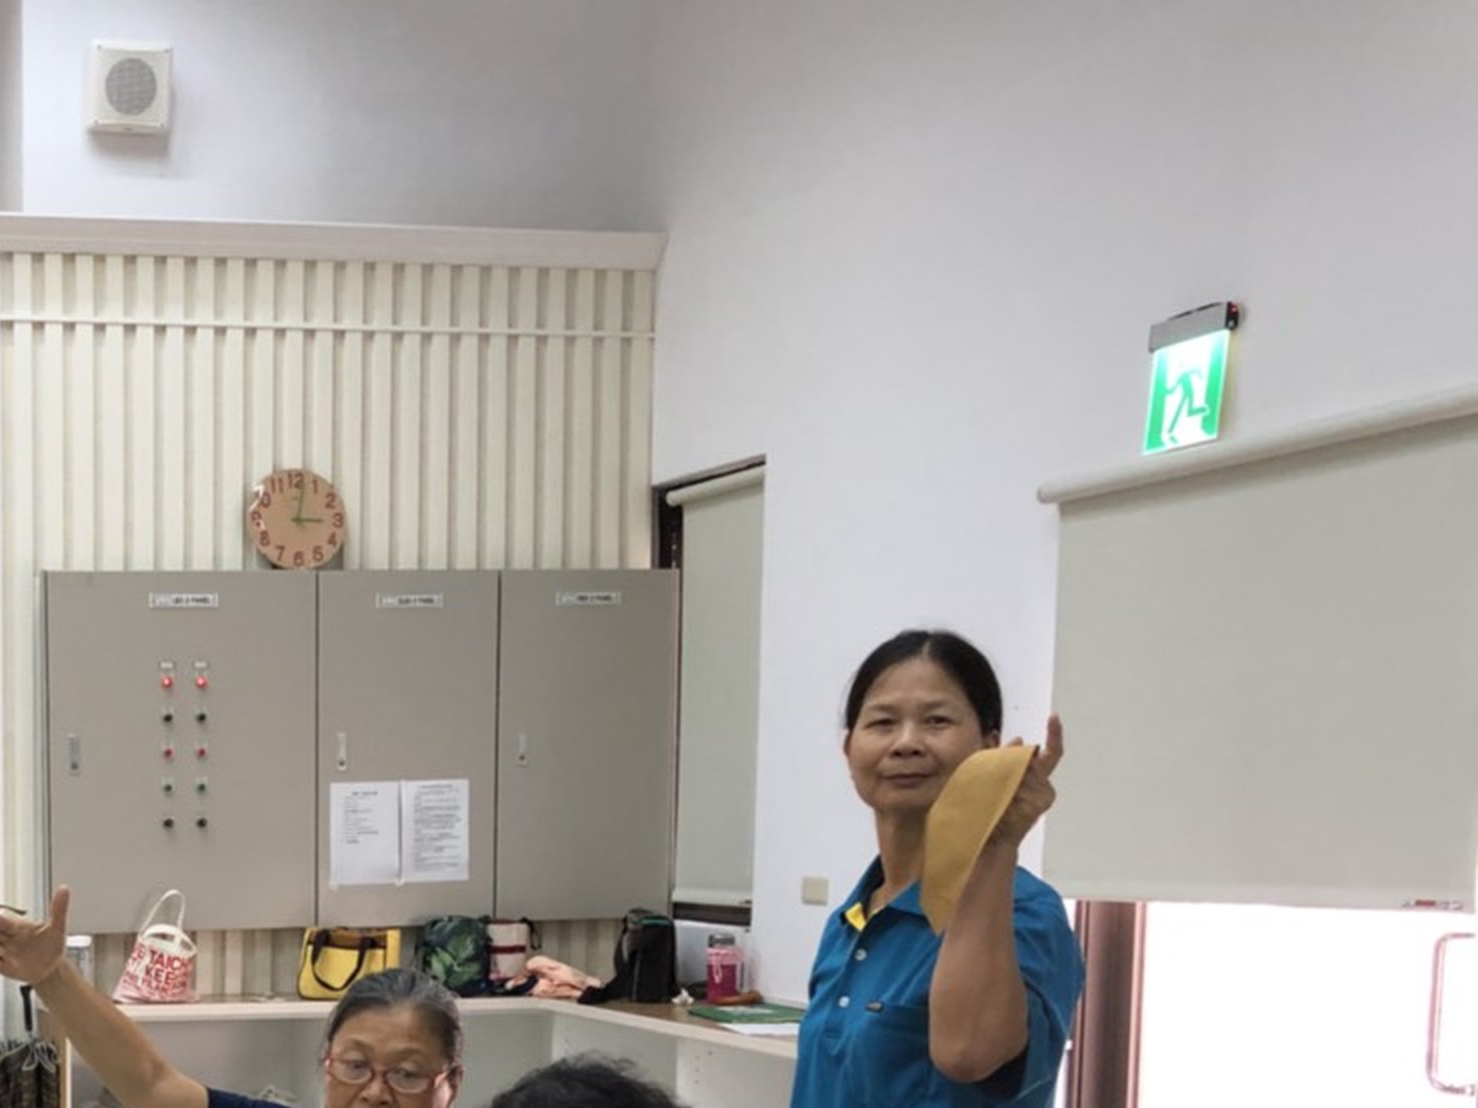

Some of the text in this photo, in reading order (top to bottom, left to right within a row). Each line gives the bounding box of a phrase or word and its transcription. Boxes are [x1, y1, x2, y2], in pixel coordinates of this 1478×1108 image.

[270, 476, 284, 494] 11
[287, 471, 304, 489] 12
[324, 492, 337, 509] 2
[331, 512, 344, 529] 3
[259, 530, 271, 547] 8
[327, 531, 338, 549] 4
[275, 544, 285, 562] 7
[292, 551, 305, 568] 6
[312, 545, 324, 562] 5
